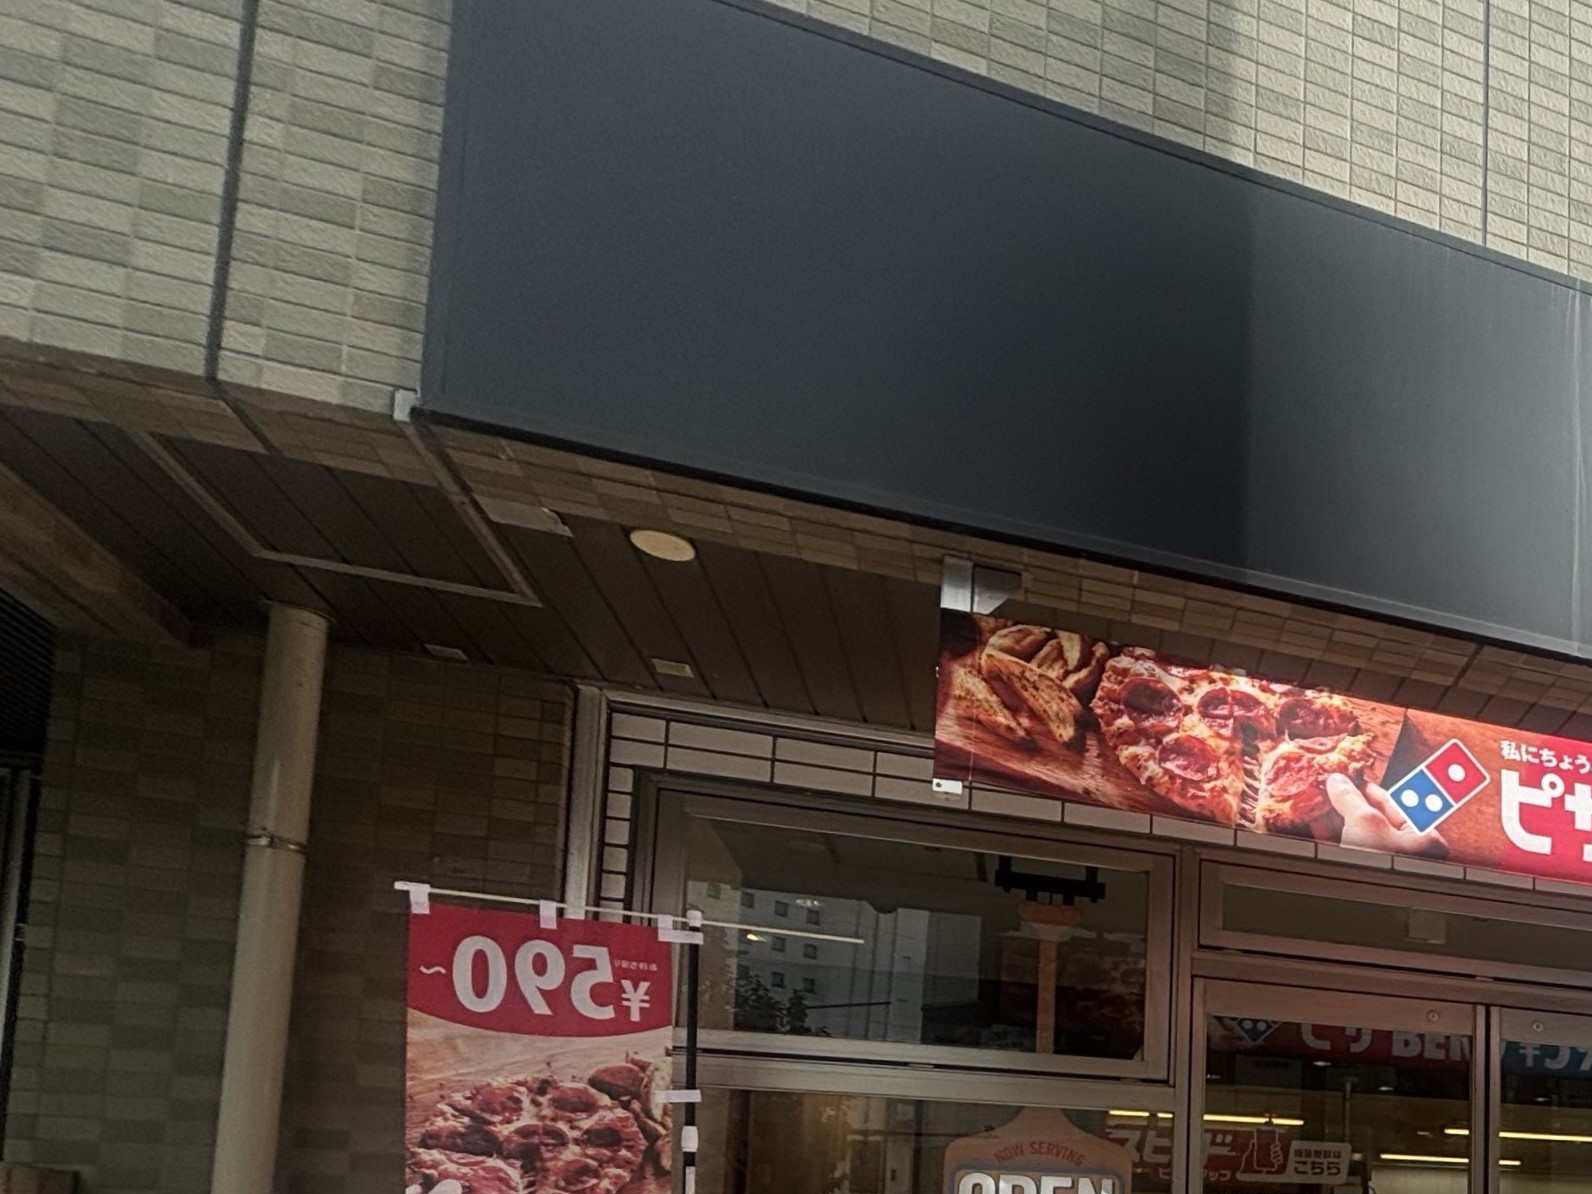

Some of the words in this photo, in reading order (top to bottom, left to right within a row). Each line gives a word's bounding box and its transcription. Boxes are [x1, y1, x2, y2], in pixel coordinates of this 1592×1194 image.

[992, 1142, 1026, 1164] NOW
[1029, 1140, 1086, 1167] SERVING
[1293, 1160, 1342, 1177] こちら
